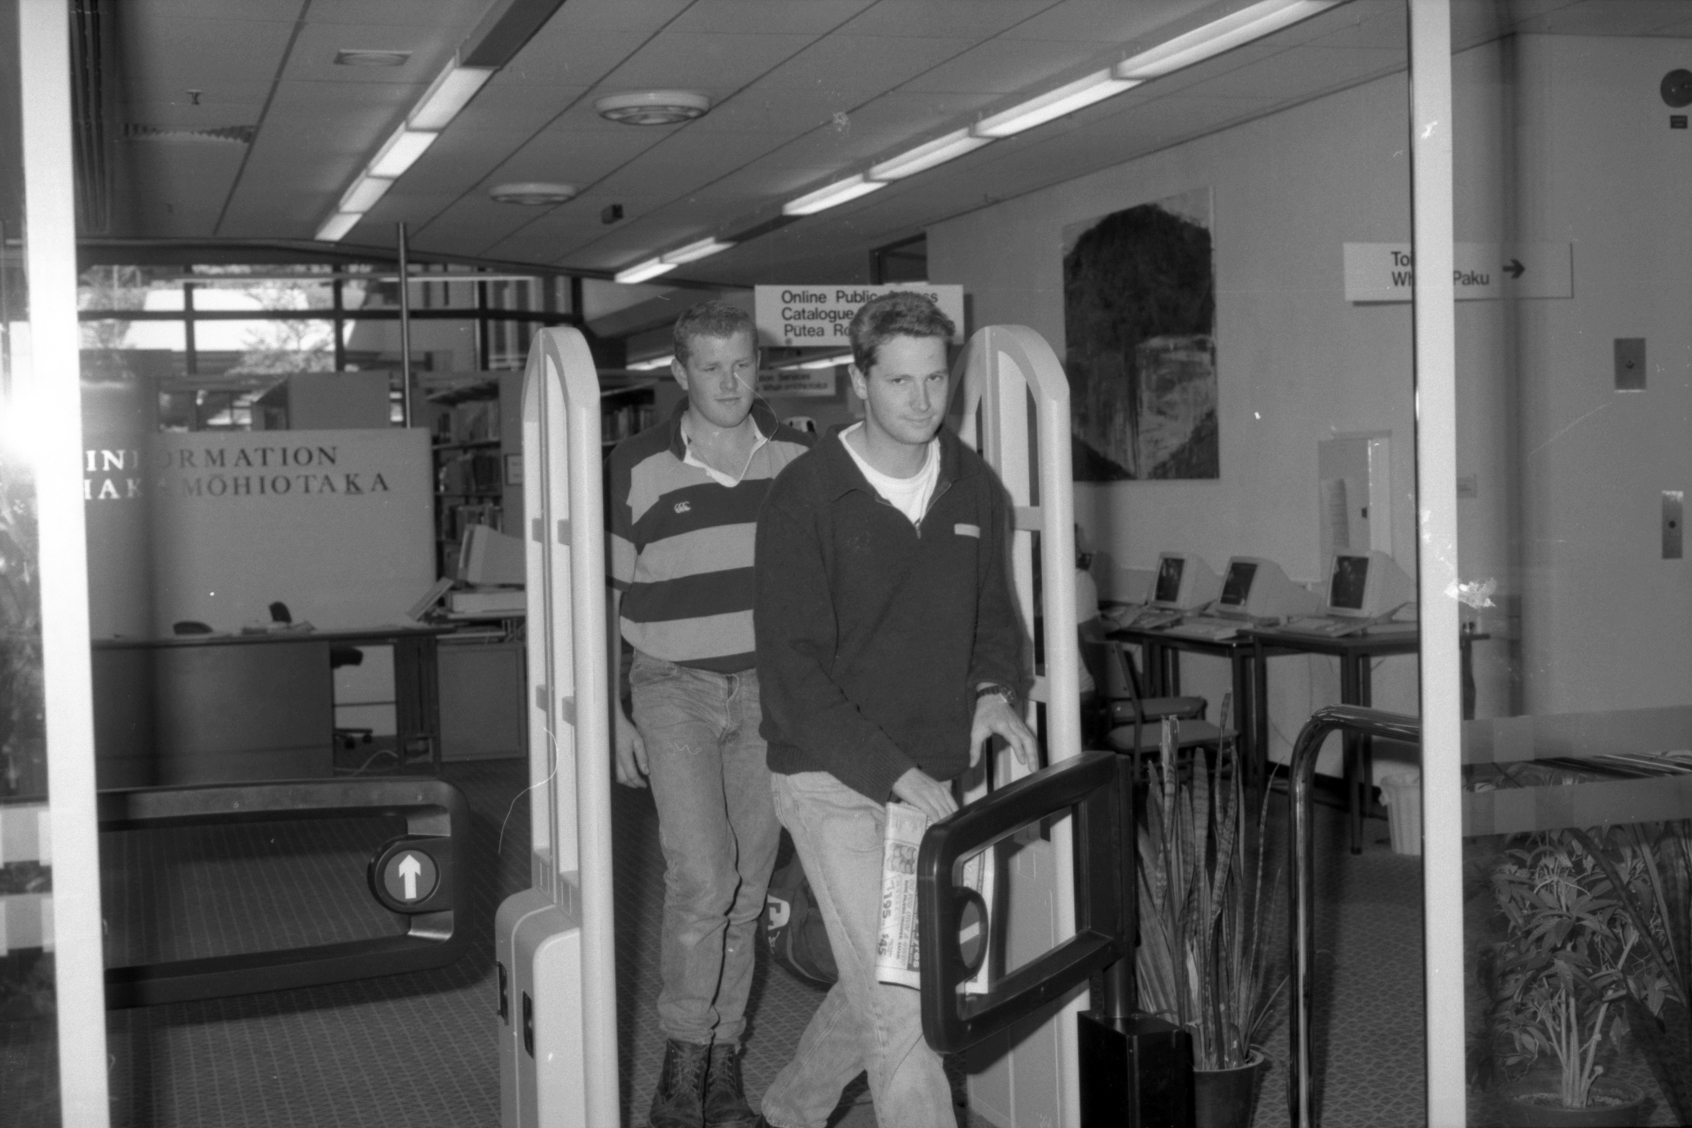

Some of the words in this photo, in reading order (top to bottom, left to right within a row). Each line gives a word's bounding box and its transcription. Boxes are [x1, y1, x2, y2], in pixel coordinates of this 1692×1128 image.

[1453, 269, 1490, 286] Paku
[781, 289, 827, 304] Online
[836, 289, 878, 304] Public
[781, 306, 855, 323] Catalogue
[834, 323, 851, 337] Ro
[86, 446, 337, 472] INORMATION
